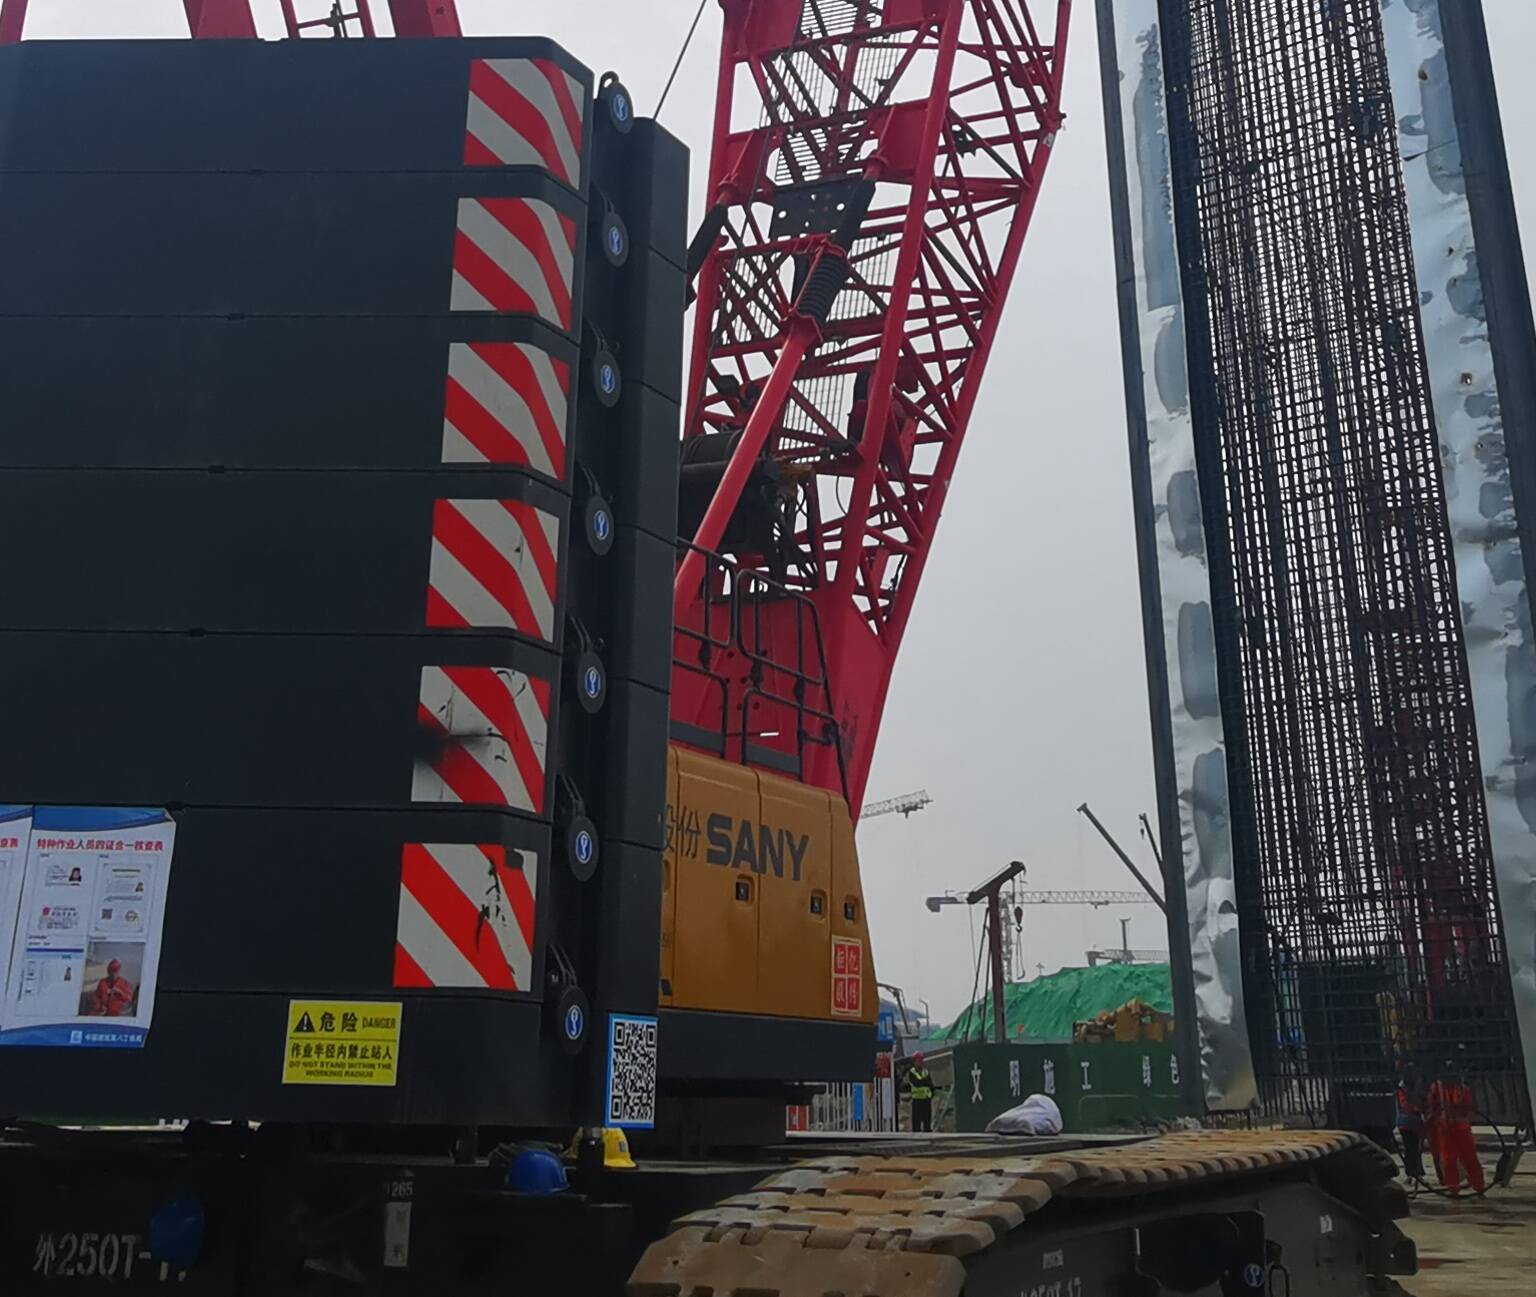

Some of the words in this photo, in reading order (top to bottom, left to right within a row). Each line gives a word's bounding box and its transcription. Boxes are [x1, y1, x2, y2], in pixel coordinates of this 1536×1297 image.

[706, 812, 809, 881] SANY
[319, 1011, 358, 1033] 危险
[362, 1016, 396, 1029] DANGER
[291, 1043, 392, 1061] 作业半径内禁止站人
